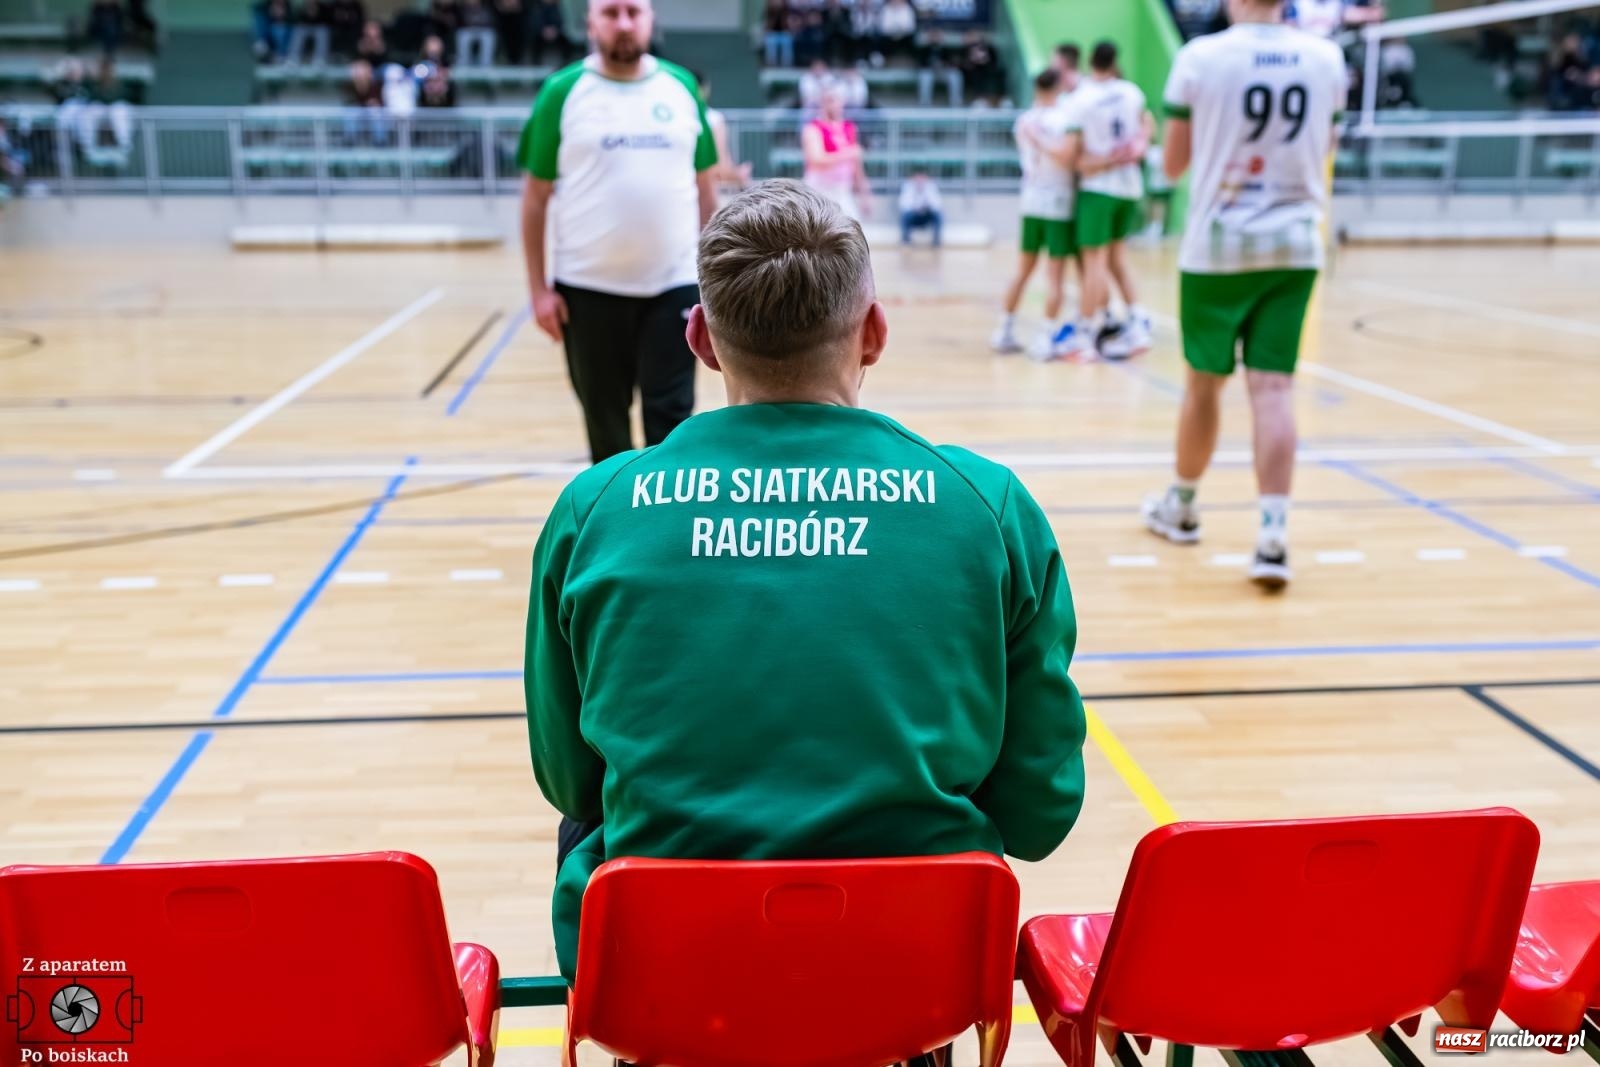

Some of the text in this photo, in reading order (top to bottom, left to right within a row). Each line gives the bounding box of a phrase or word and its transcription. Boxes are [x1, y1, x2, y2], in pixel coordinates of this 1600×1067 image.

[1244, 83, 1308, 143] 99
[631, 467, 936, 508] KLUB SIATKARSKI
[691, 510, 869, 557] RACIBÓRZ
